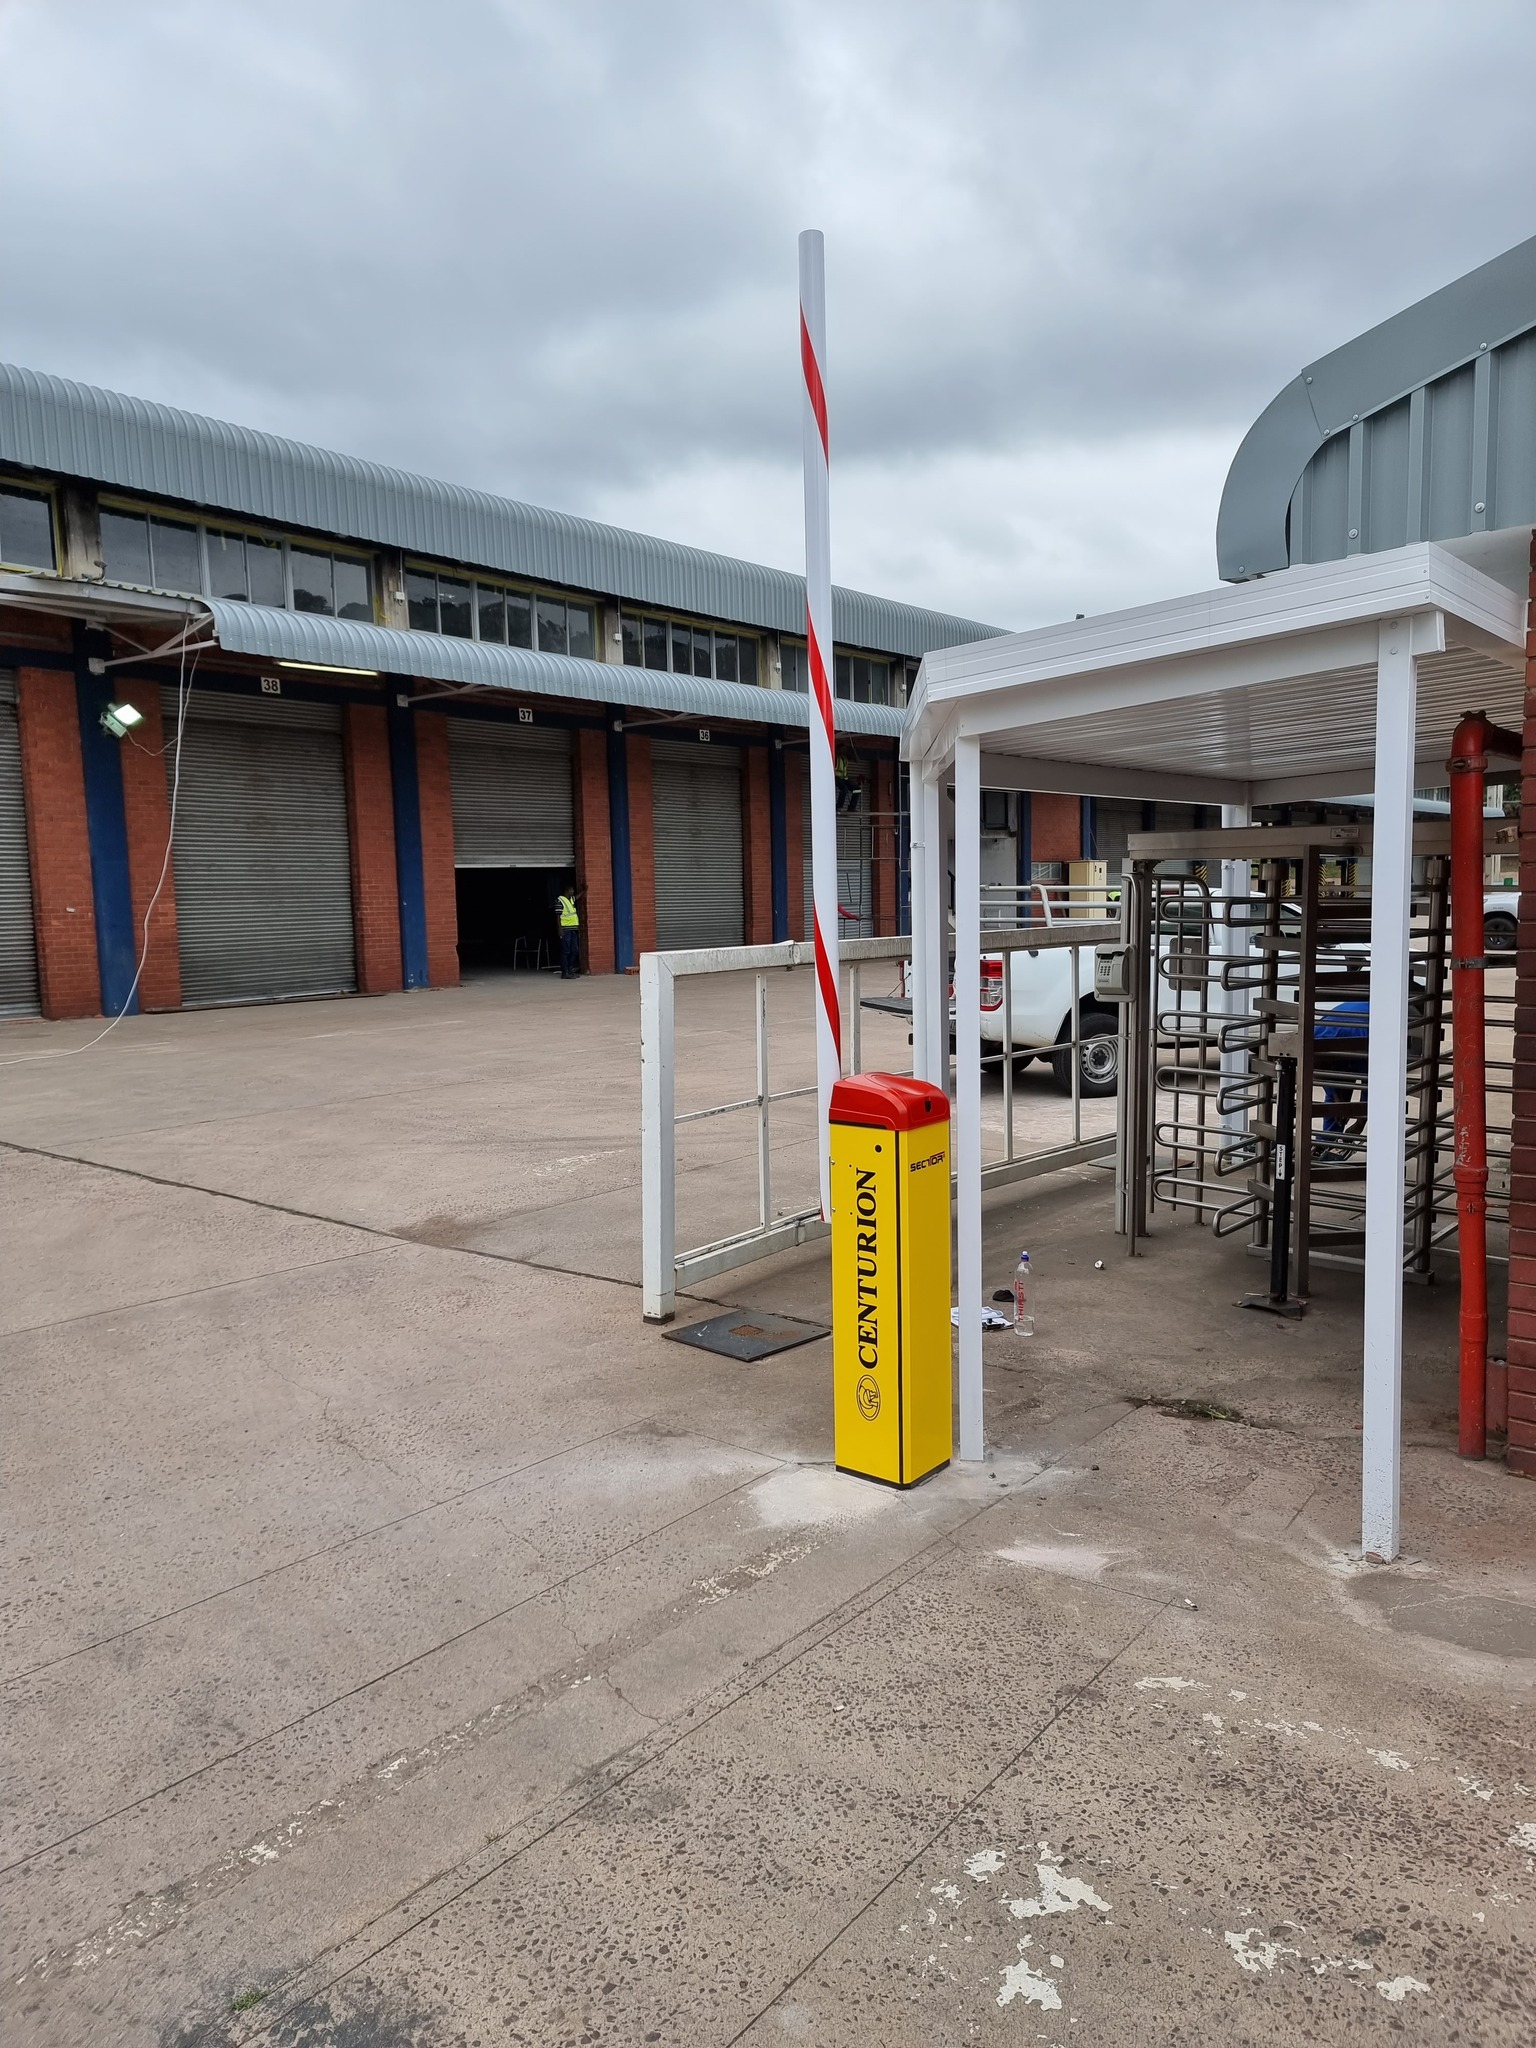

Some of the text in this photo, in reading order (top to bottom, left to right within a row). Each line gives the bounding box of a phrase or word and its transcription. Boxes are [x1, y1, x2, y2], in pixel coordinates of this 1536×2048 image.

[263, 679, 279, 692] 38
[520, 709, 531, 721] 37
[910, 1151, 945, 1172] SECTOR
[856, 1167, 878, 1370] CENTURION
